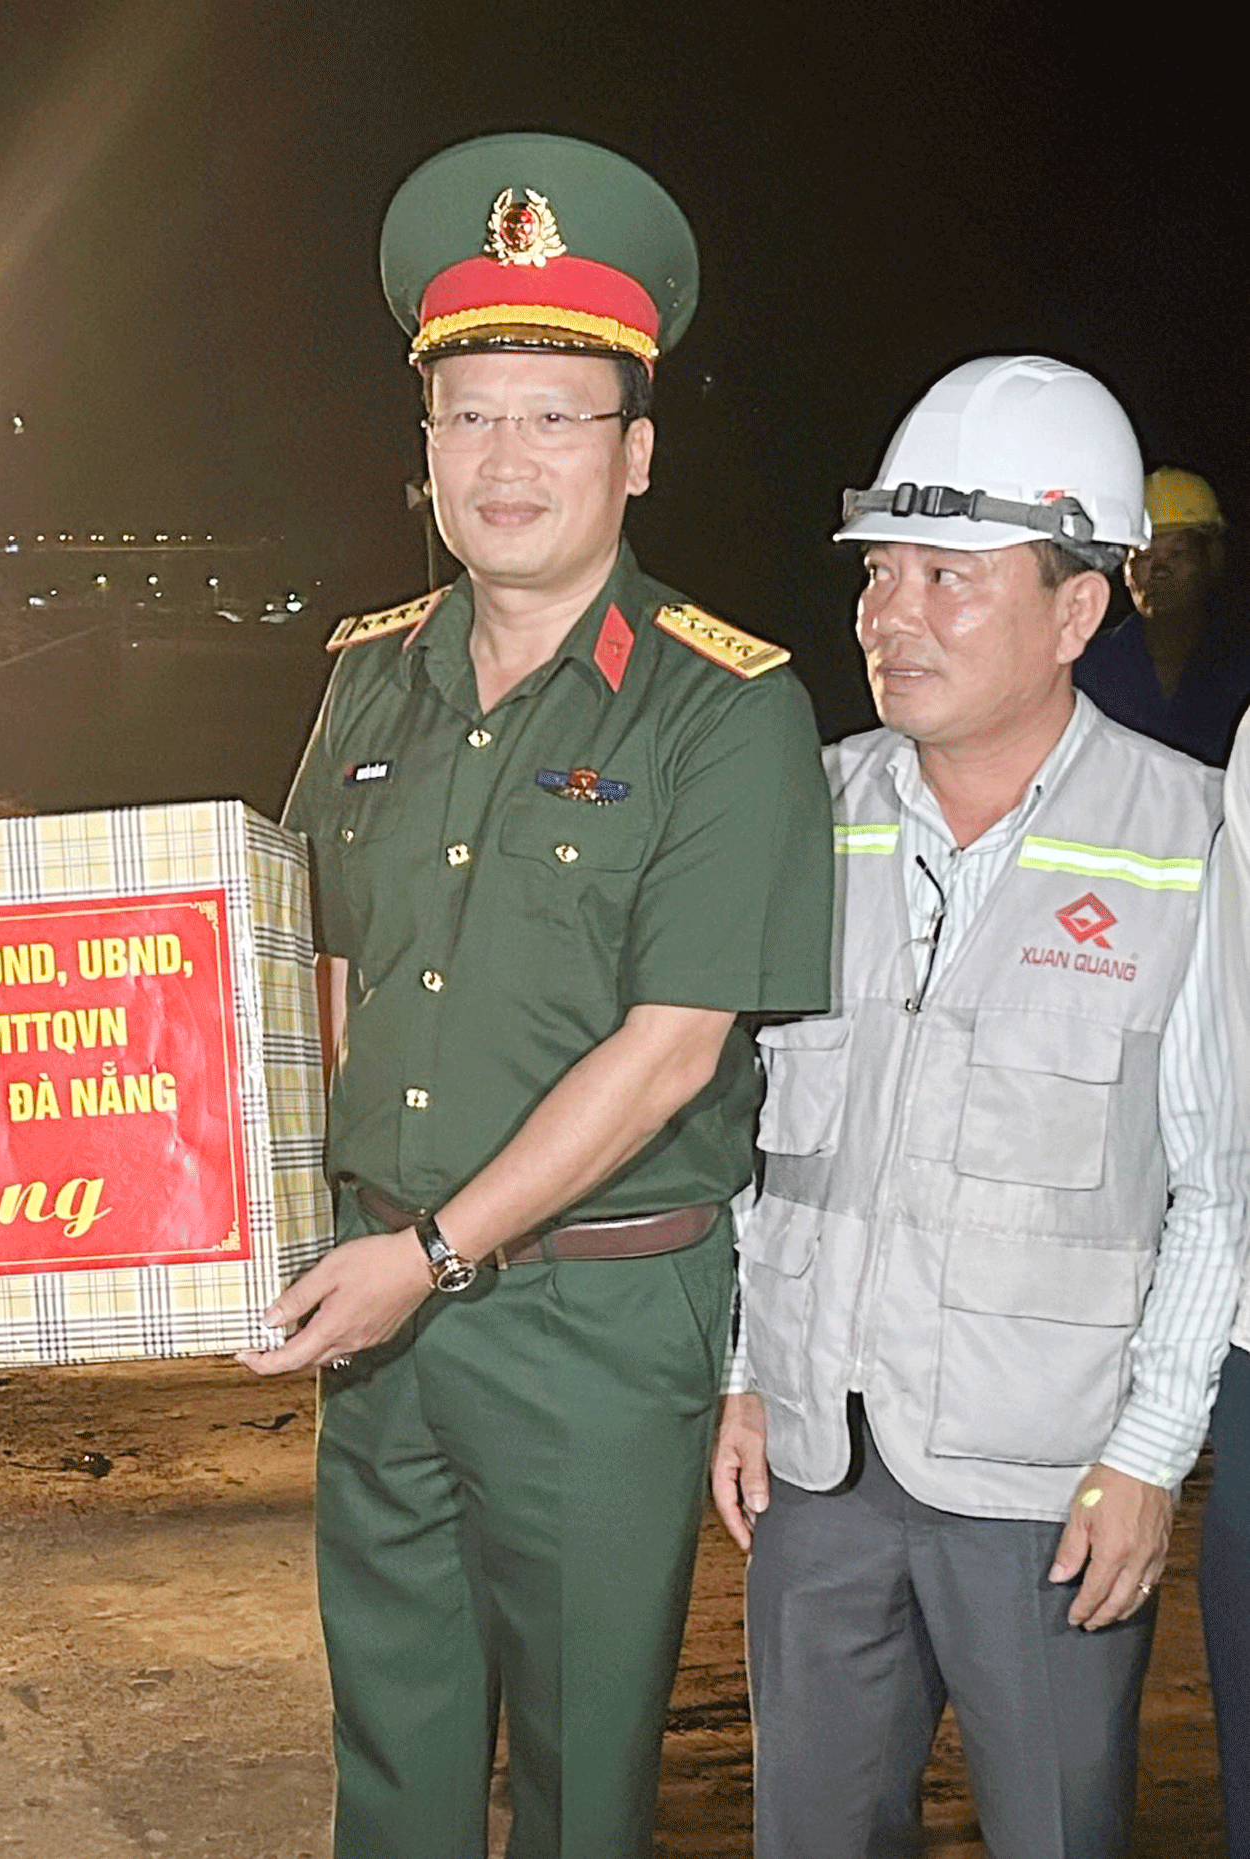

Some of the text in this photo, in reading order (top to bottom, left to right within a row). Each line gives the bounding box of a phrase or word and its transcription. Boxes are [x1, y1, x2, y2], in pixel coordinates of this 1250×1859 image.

[78, 933, 194, 980] UBND,
[1020, 947, 1137, 982] XUAN QUANG
[8, 1072, 61, 1123] ĐÀ
[69, 1060, 178, 1116] NẴNG
